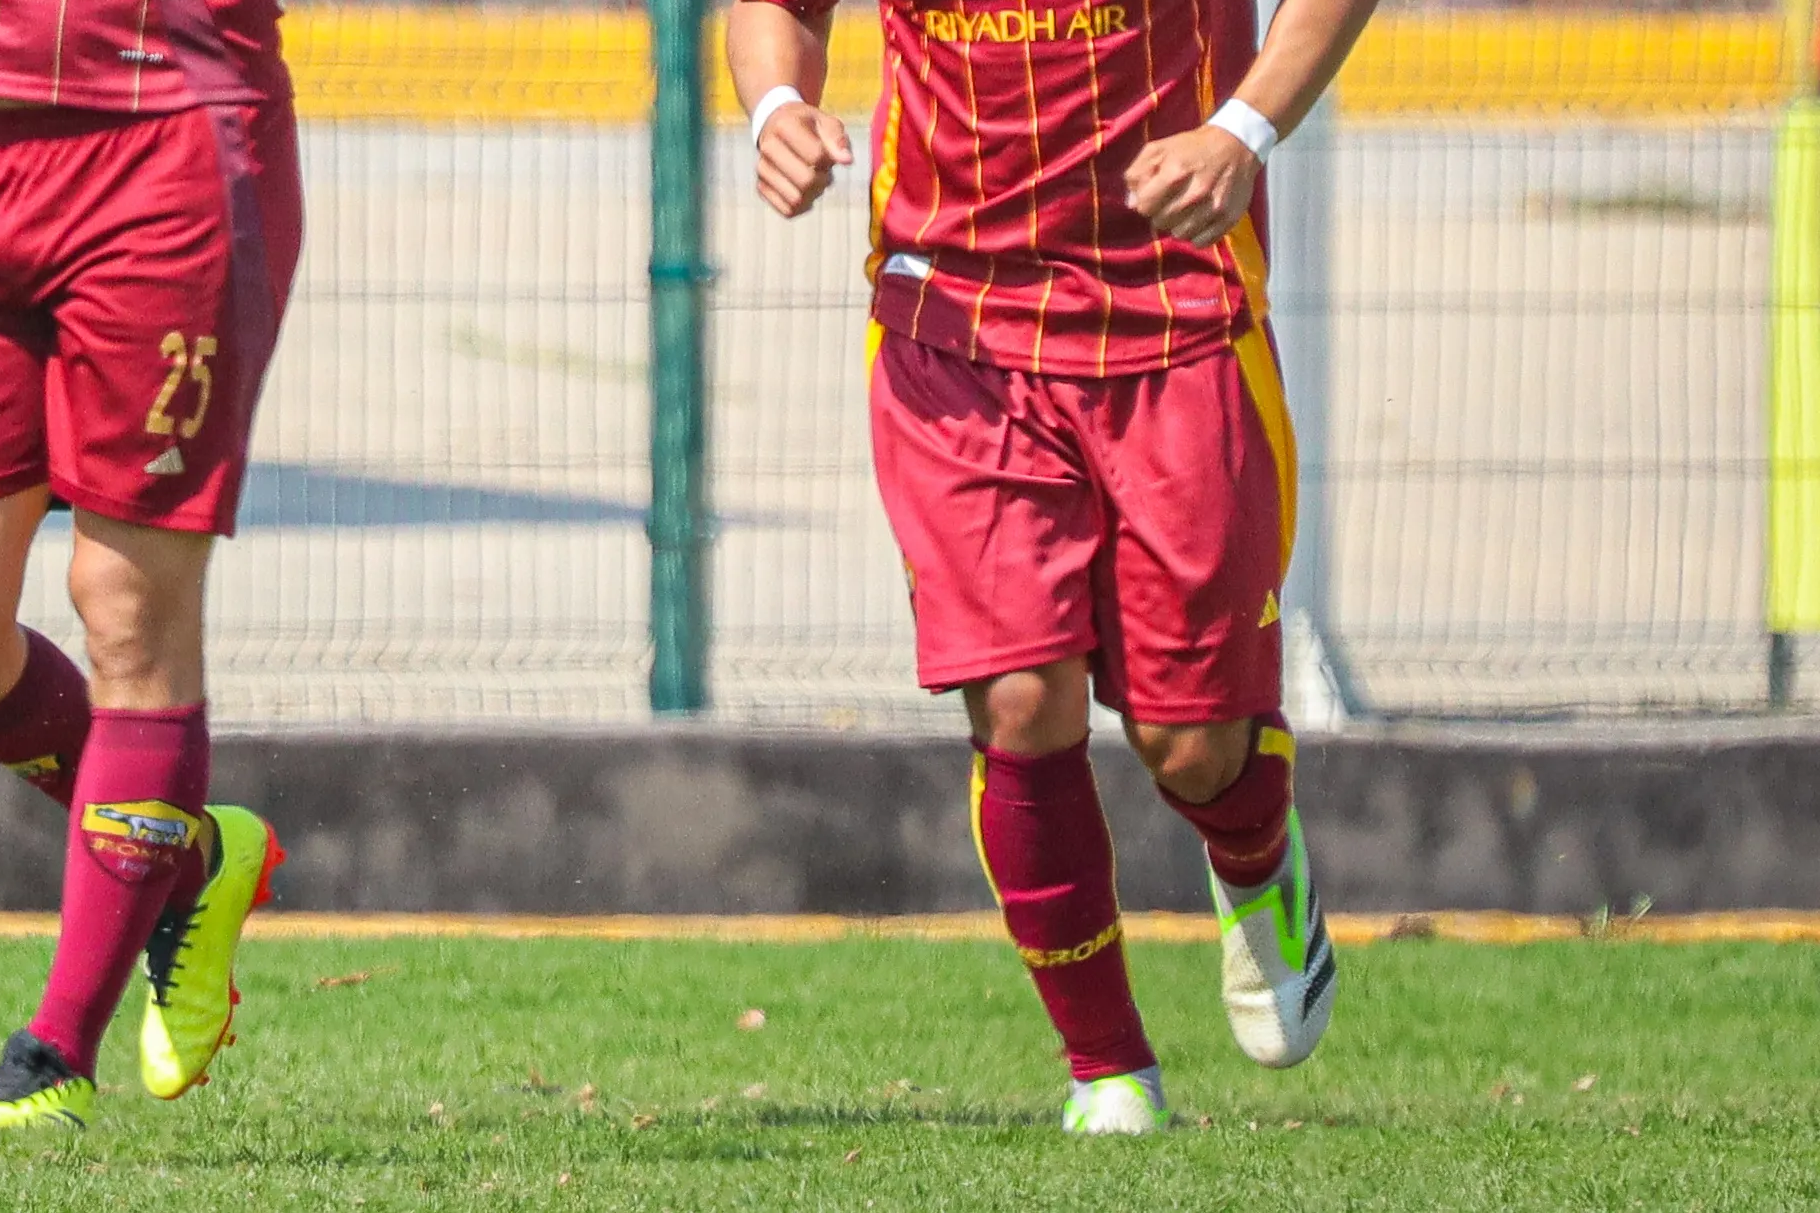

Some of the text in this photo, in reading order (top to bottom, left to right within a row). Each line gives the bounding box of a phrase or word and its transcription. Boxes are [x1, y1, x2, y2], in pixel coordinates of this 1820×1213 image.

[926, 4, 1128, 42] RIYADH AIR
[146, 330, 217, 439] 25
